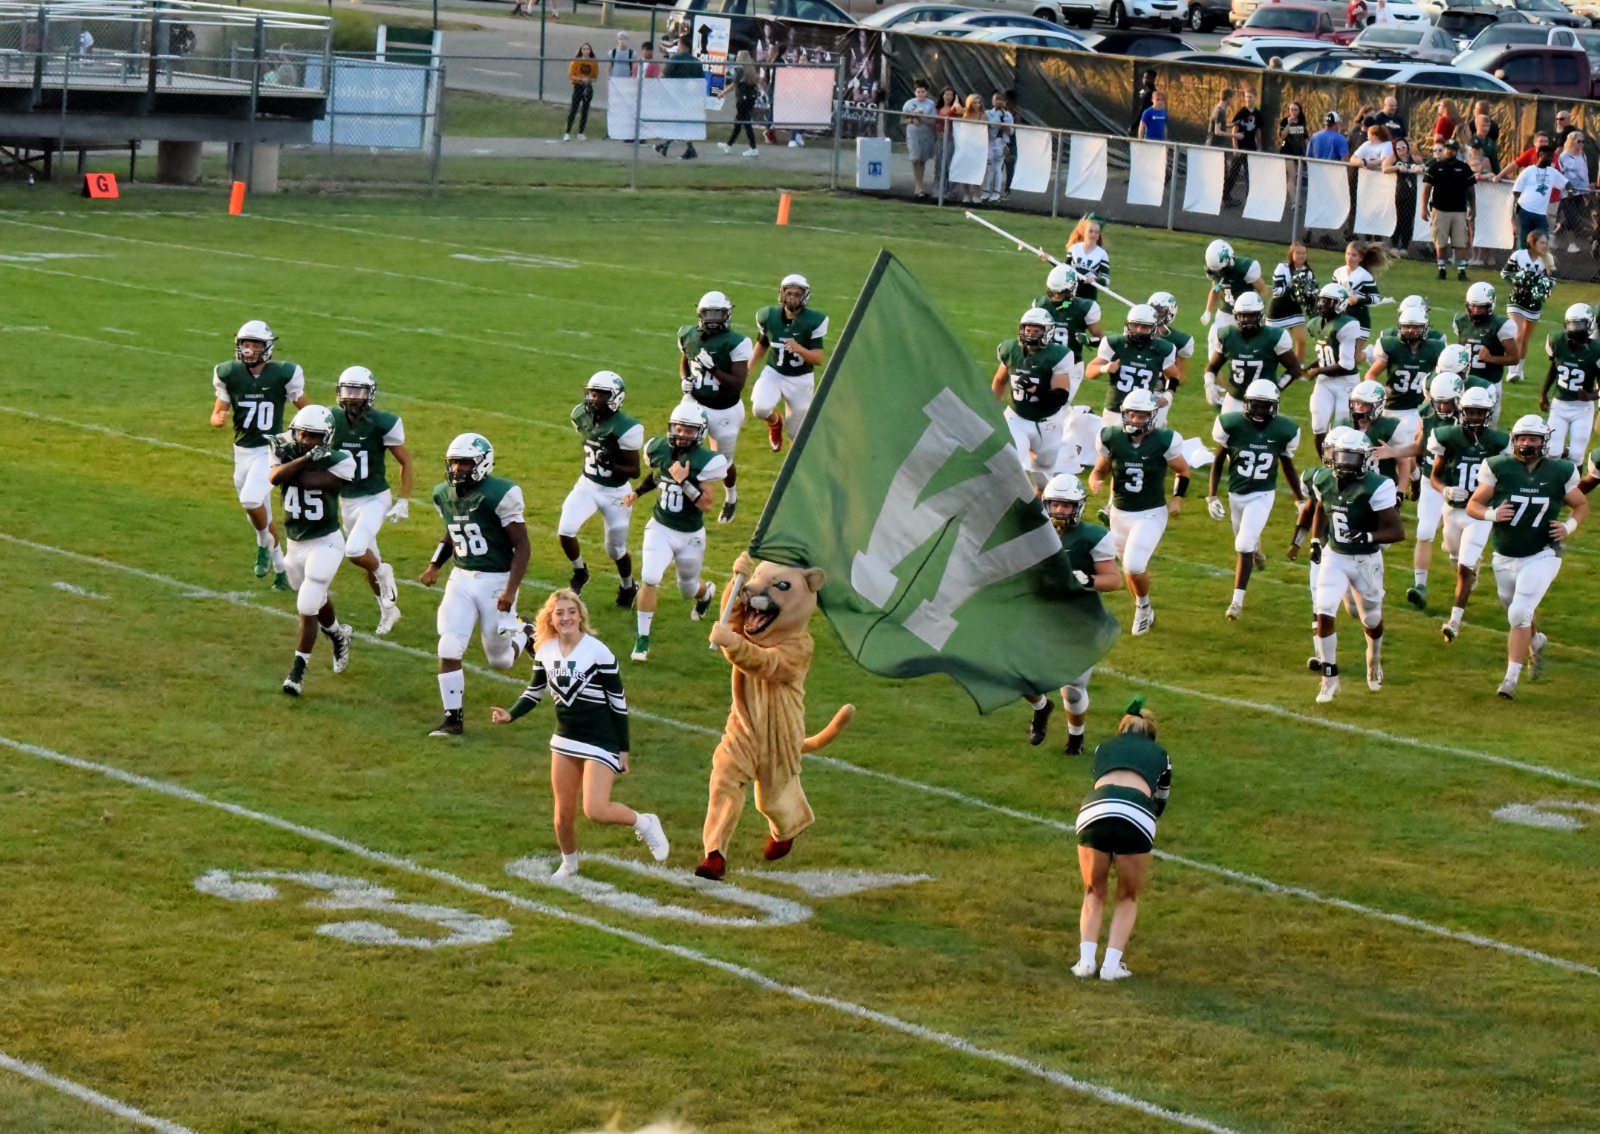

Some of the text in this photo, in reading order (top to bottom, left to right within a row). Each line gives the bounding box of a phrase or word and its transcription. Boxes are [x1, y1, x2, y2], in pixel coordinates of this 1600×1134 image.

[96, 174, 109, 193] G
[1116, 364, 1153, 393] 53
[1231, 359, 1263, 384] 57
[1393, 370, 1427, 394] 34
[1556, 365, 1585, 391] 22
[237, 401, 275, 431] 70
[1124, 467, 1145, 493] 3
[1237, 450, 1274, 480] 32
[284, 485, 324, 521] 45
[657, 481, 683, 513] 10
[1509, 494, 1550, 528] 77
[851, 387, 1062, 651] W
[1332, 511, 1352, 543] 6
[446, 522, 489, 558] 58
[546, 666, 587, 682] COUGARS
